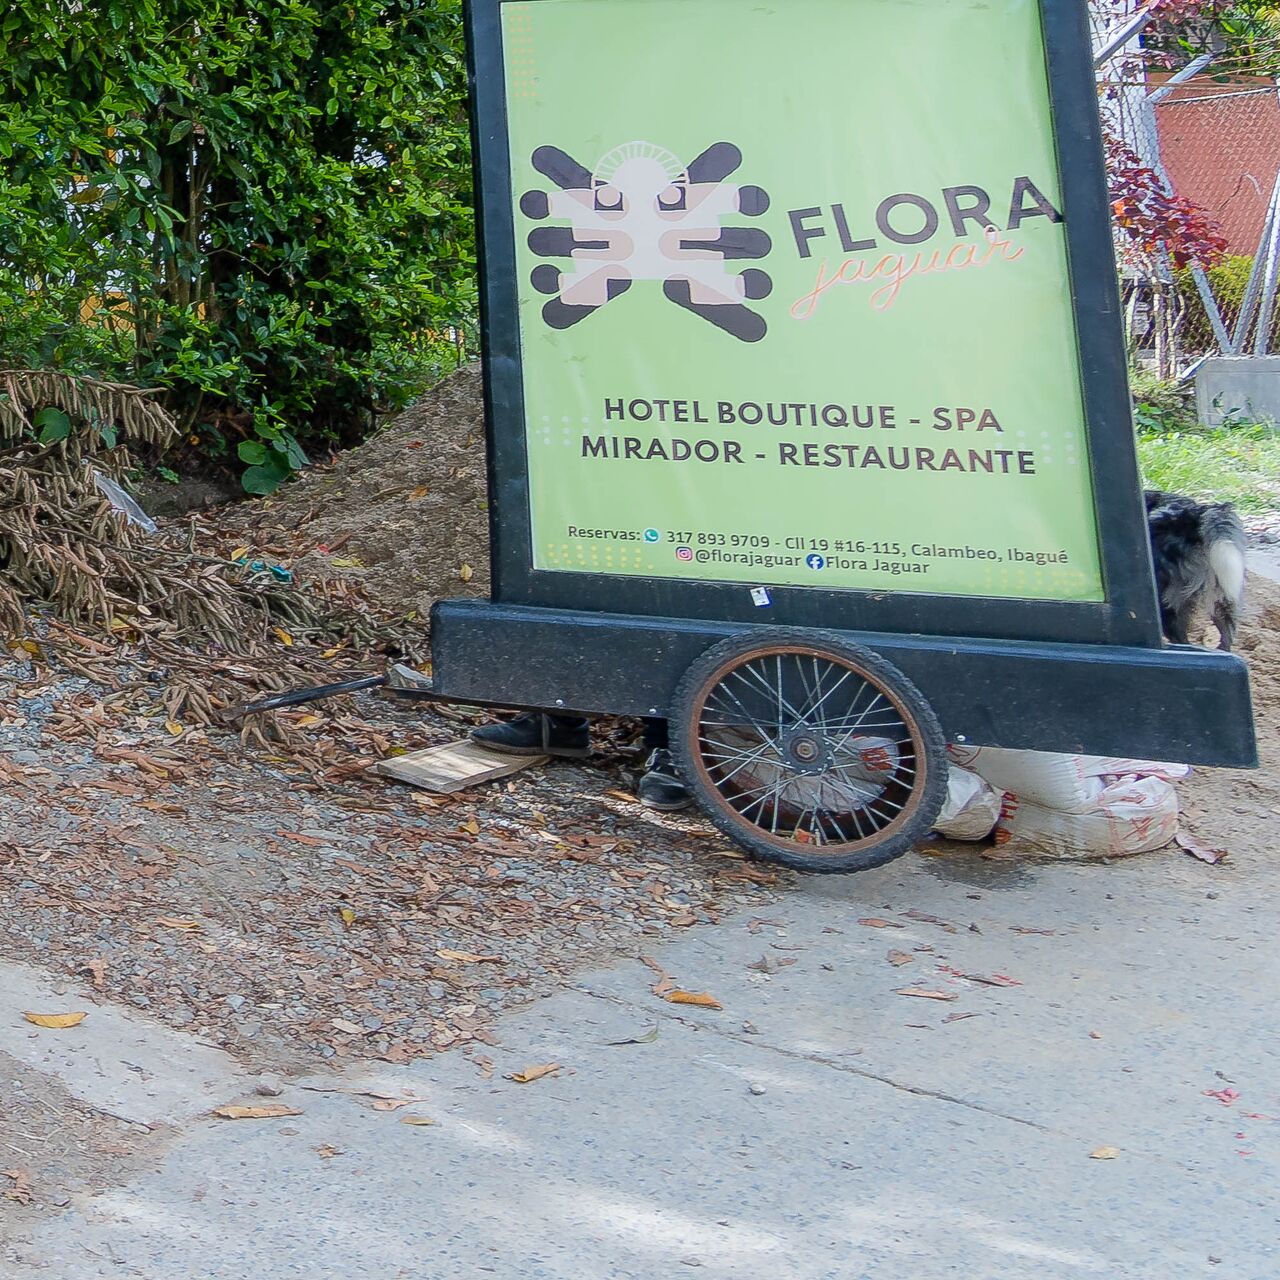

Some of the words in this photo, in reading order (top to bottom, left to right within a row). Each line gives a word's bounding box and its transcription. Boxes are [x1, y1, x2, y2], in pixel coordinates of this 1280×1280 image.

[787, 175, 1064, 258] FLORA
[790, 223, 1024, 320] jaguar
[604, 398, 709, 424] HOTEL
[717, 401, 896, 429] BOUTIQUE
[932, 407, 1004, 432] SPA
[581, 435, 745, 464] MIRADOR
[779, 442, 1037, 475] RESTAURANTE
[568, 526, 641, 541] Reservas:
[666, 531, 693, 543] 317
[697, 533, 726, 546] 893
[731, 535, 770, 548] 9709
[810, 539, 829, 551] 19
[834, 540, 907, 558] #16-115,
[911, 544, 1003, 562] Calambeo,
[1007, 548, 1069, 566] Ibagué
[695, 548, 802, 568] @florajaguar
[826, 556, 868, 570] Flora
[872, 559, 930, 575] Jaguar
